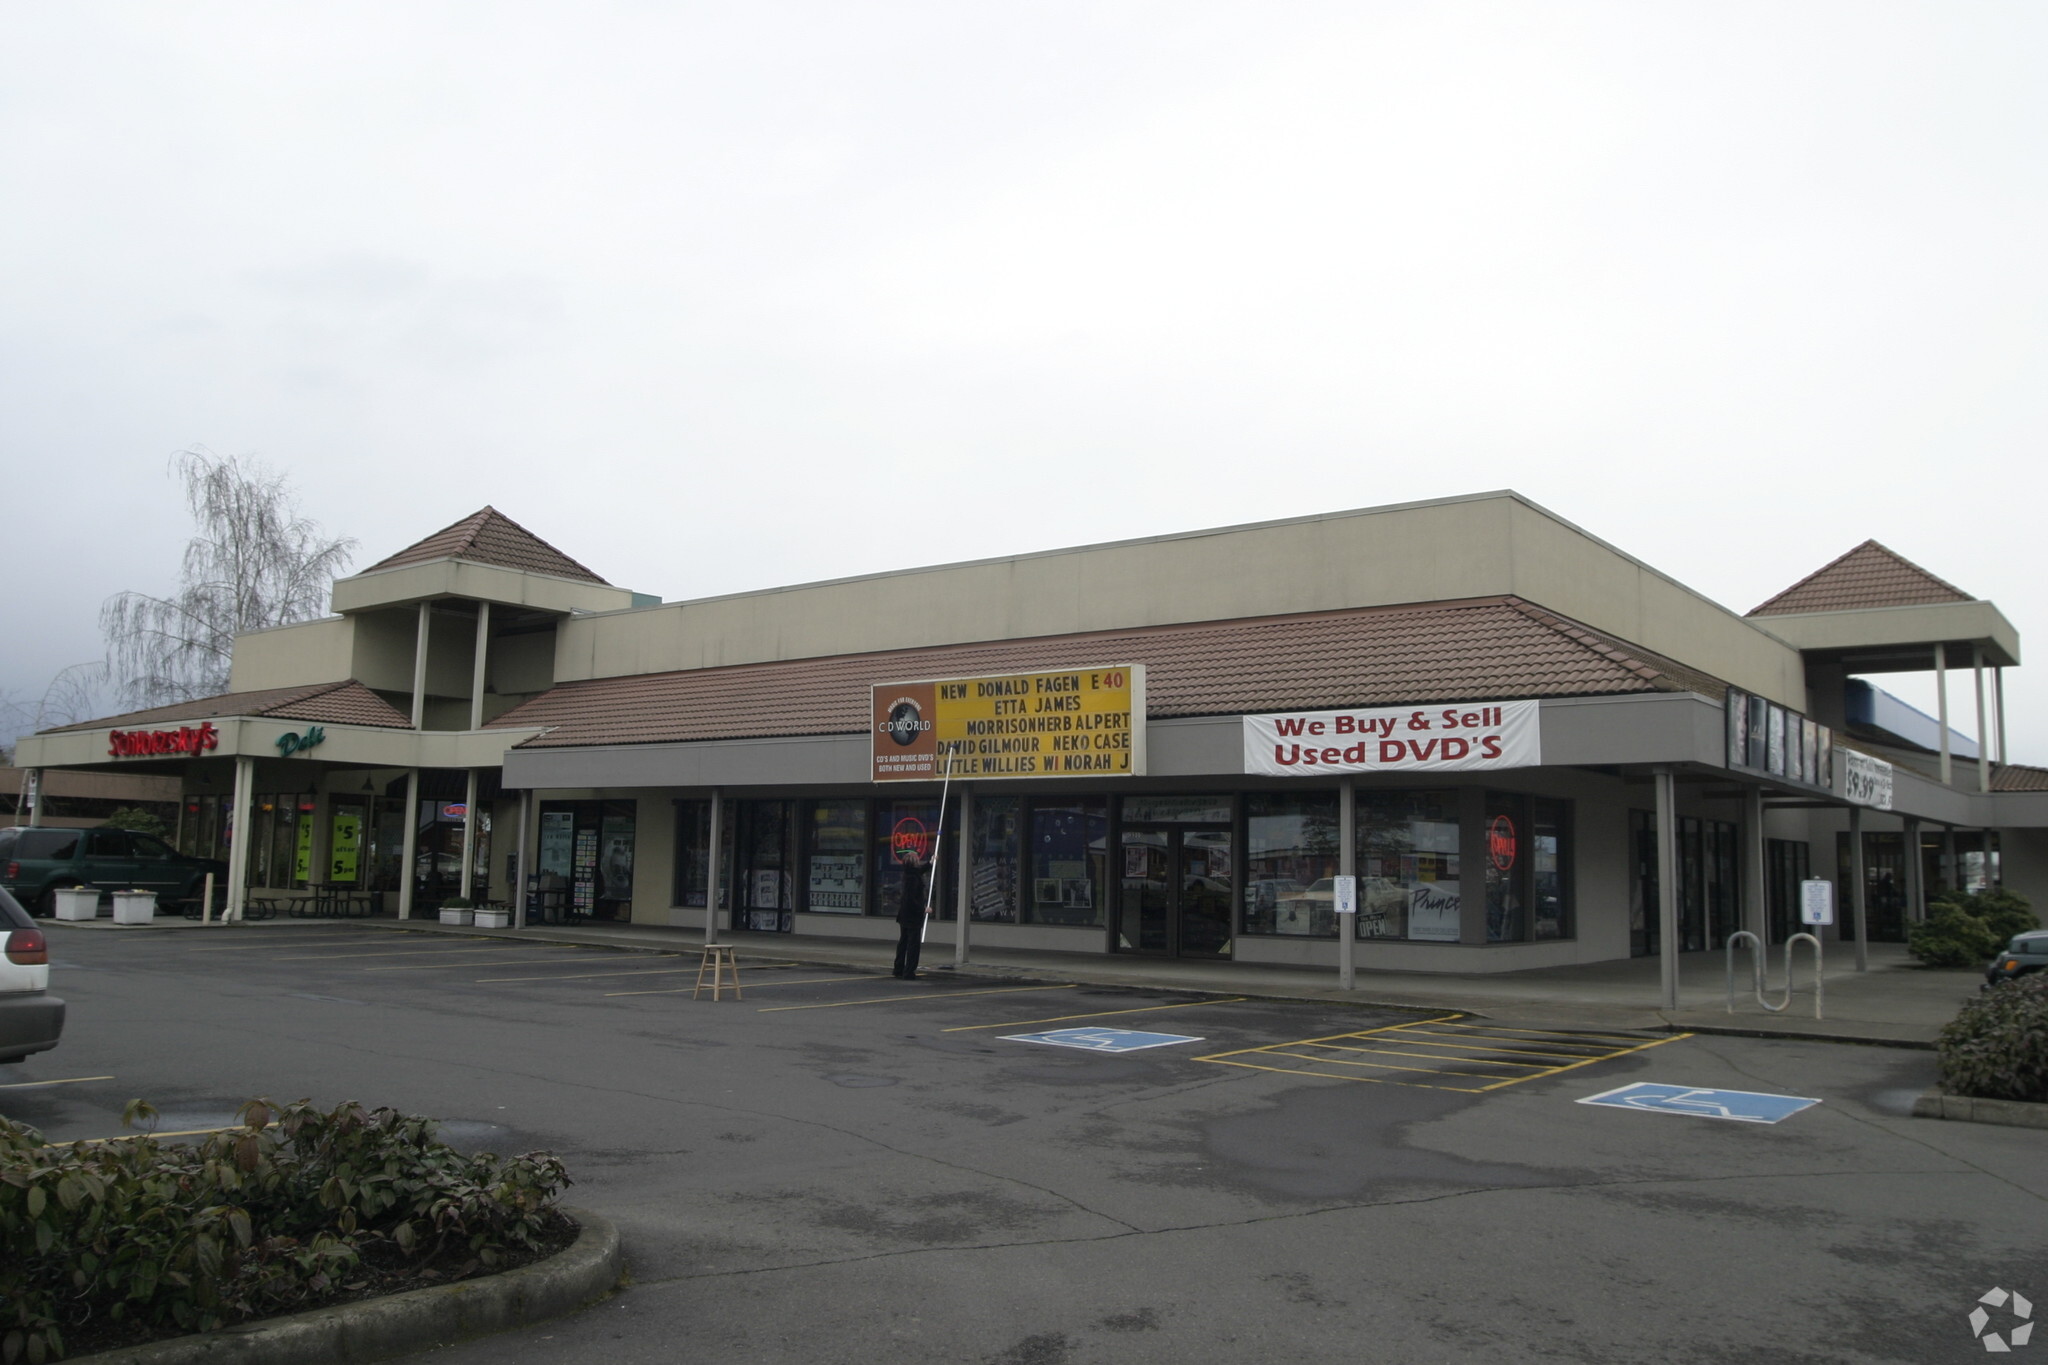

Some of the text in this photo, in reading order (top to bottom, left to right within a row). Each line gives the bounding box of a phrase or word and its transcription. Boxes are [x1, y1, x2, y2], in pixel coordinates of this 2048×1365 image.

[941, 672, 1123, 700] NEW DONALD FAGEN E 40
[994, 696, 1081, 716] ETTA JAMES
[1075, 712, 1131, 732] ALPERT
[1275, 707, 1502, 738] We Buy & Sell
[275, 726, 326, 756] Deli
[937, 733, 1129, 755] DAVID GILMOUR NEKO CASE
[1275, 736, 1503, 766] Used DVD'S
[879, 763, 931, 772] BOTH NEW AND USED
[901, 754, 917, 762] MUSIC
[936, 758, 978, 774] LITTLE
[982, 756, 1036, 773] WILLIES
[1064, 754, 1111, 771] NORAH
[1119, 753, 1130, 769] J
[336, 825, 354, 840] $5
[1410, 888, 1460, 919] Prince
[1359, 919, 1386, 937] OPEN
